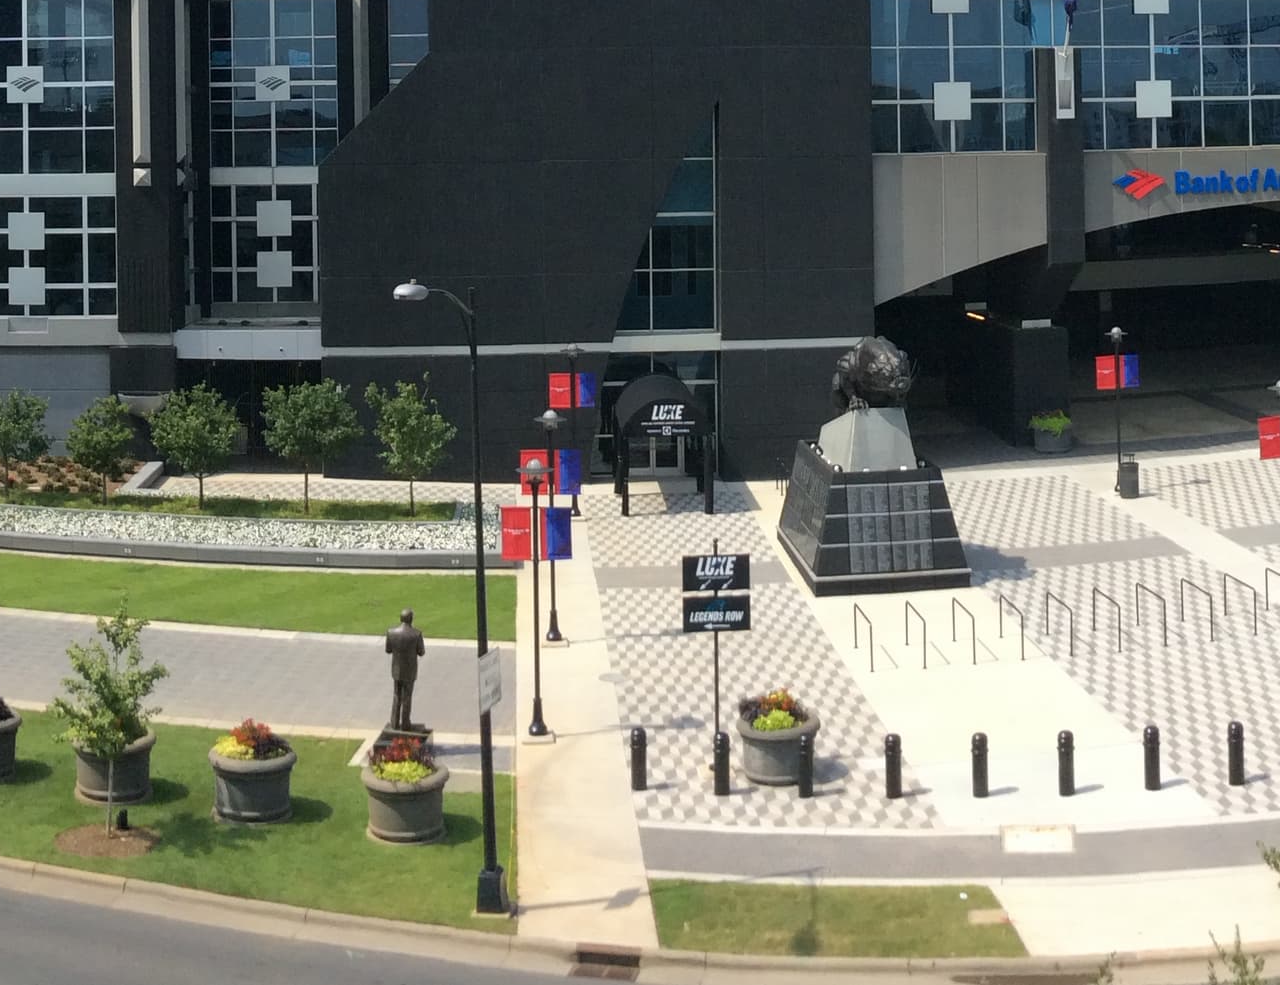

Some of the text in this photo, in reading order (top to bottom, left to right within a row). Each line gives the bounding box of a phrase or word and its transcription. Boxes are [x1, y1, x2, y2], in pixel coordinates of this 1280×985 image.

[1174, 169, 1234, 195] Bank
[1235, 168, 1260, 194] of
[651, 404, 685, 421] LUXE
[696, 556, 737, 577] LUXE
[689, 610, 744, 623] LEGENDS ROW
